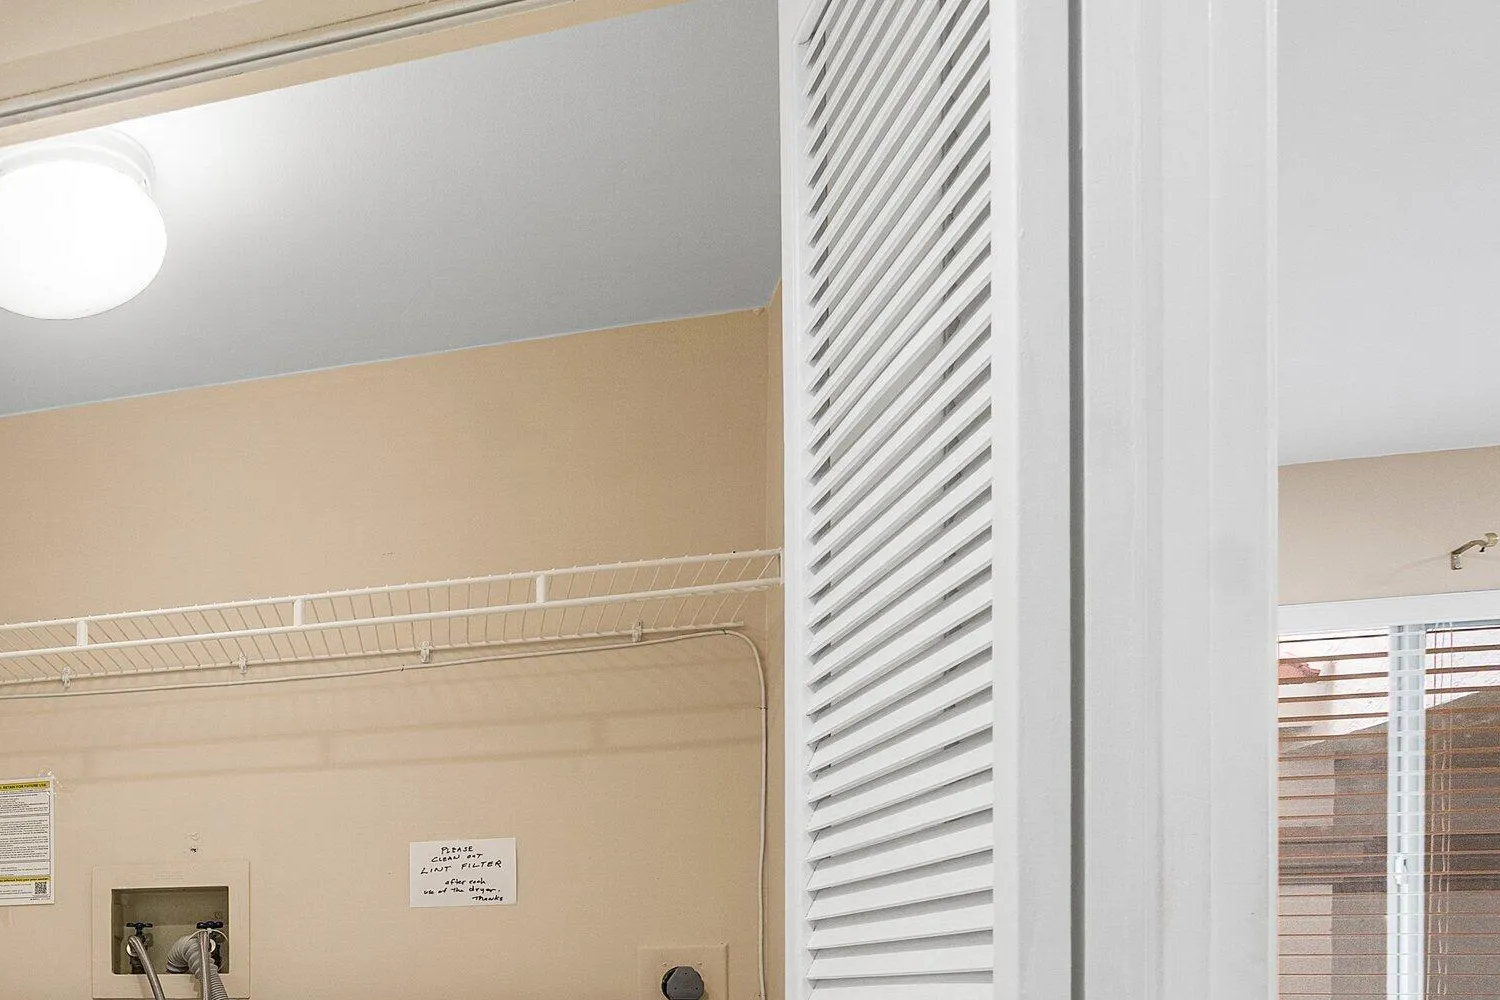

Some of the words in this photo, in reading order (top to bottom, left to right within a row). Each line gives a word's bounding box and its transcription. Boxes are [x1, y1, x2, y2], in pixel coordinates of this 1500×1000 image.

[441, 846, 474, 855] PLEASE
[431, 854, 460, 863] CLEAN
[420, 865, 451, 875] LINT
[461, 859, 502, 870] FILTER
